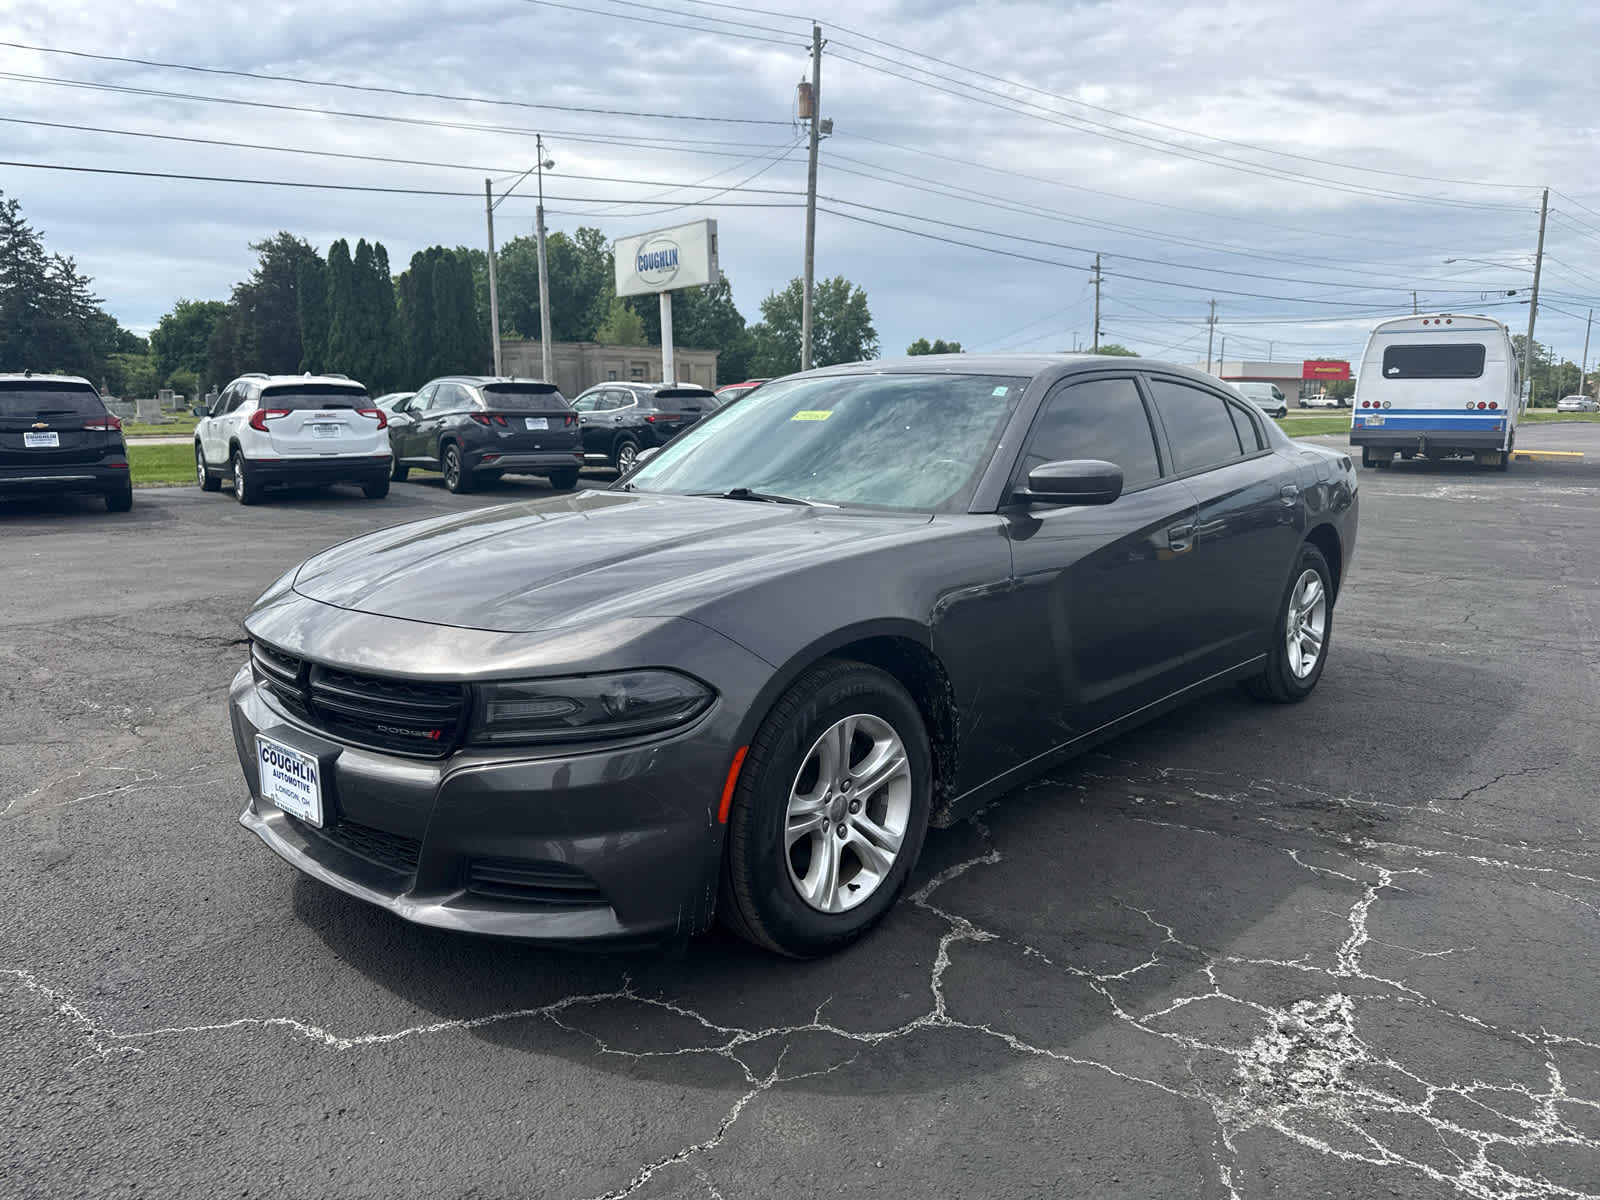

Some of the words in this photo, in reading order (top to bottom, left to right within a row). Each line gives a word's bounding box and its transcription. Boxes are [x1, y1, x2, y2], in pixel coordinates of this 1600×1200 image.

[637, 247, 679, 273] COUGHLIN
[377, 725, 433, 738] DODGE
[262, 748, 317, 784] COUGHLIN
[272, 768, 311, 795] AUTOMOTIVE
